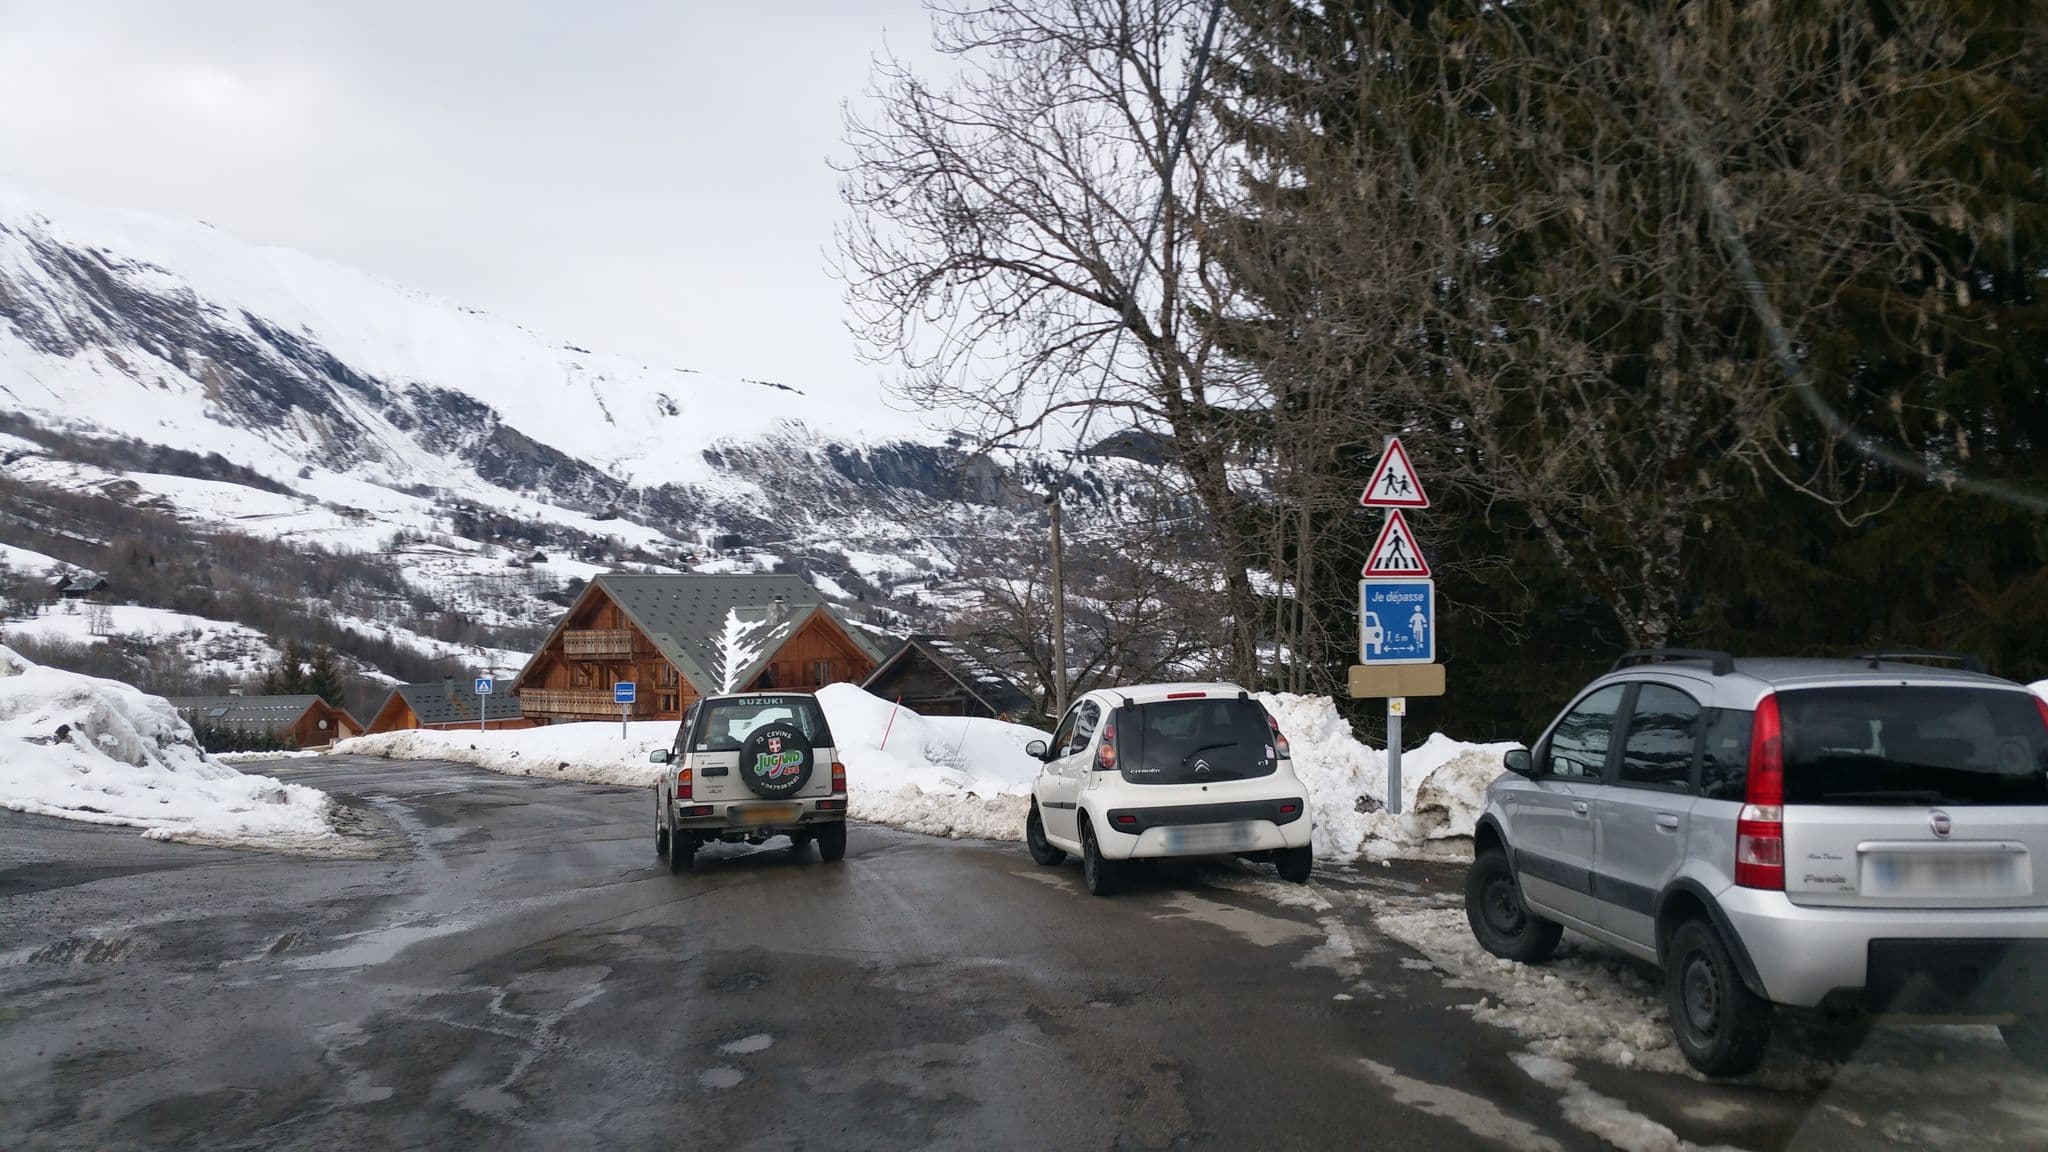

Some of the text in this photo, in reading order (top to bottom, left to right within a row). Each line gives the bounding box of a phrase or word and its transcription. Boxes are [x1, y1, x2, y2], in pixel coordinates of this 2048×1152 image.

[1372, 588, 1424, 604] Je dépasse
[767, 730, 792, 739] CEVINS
